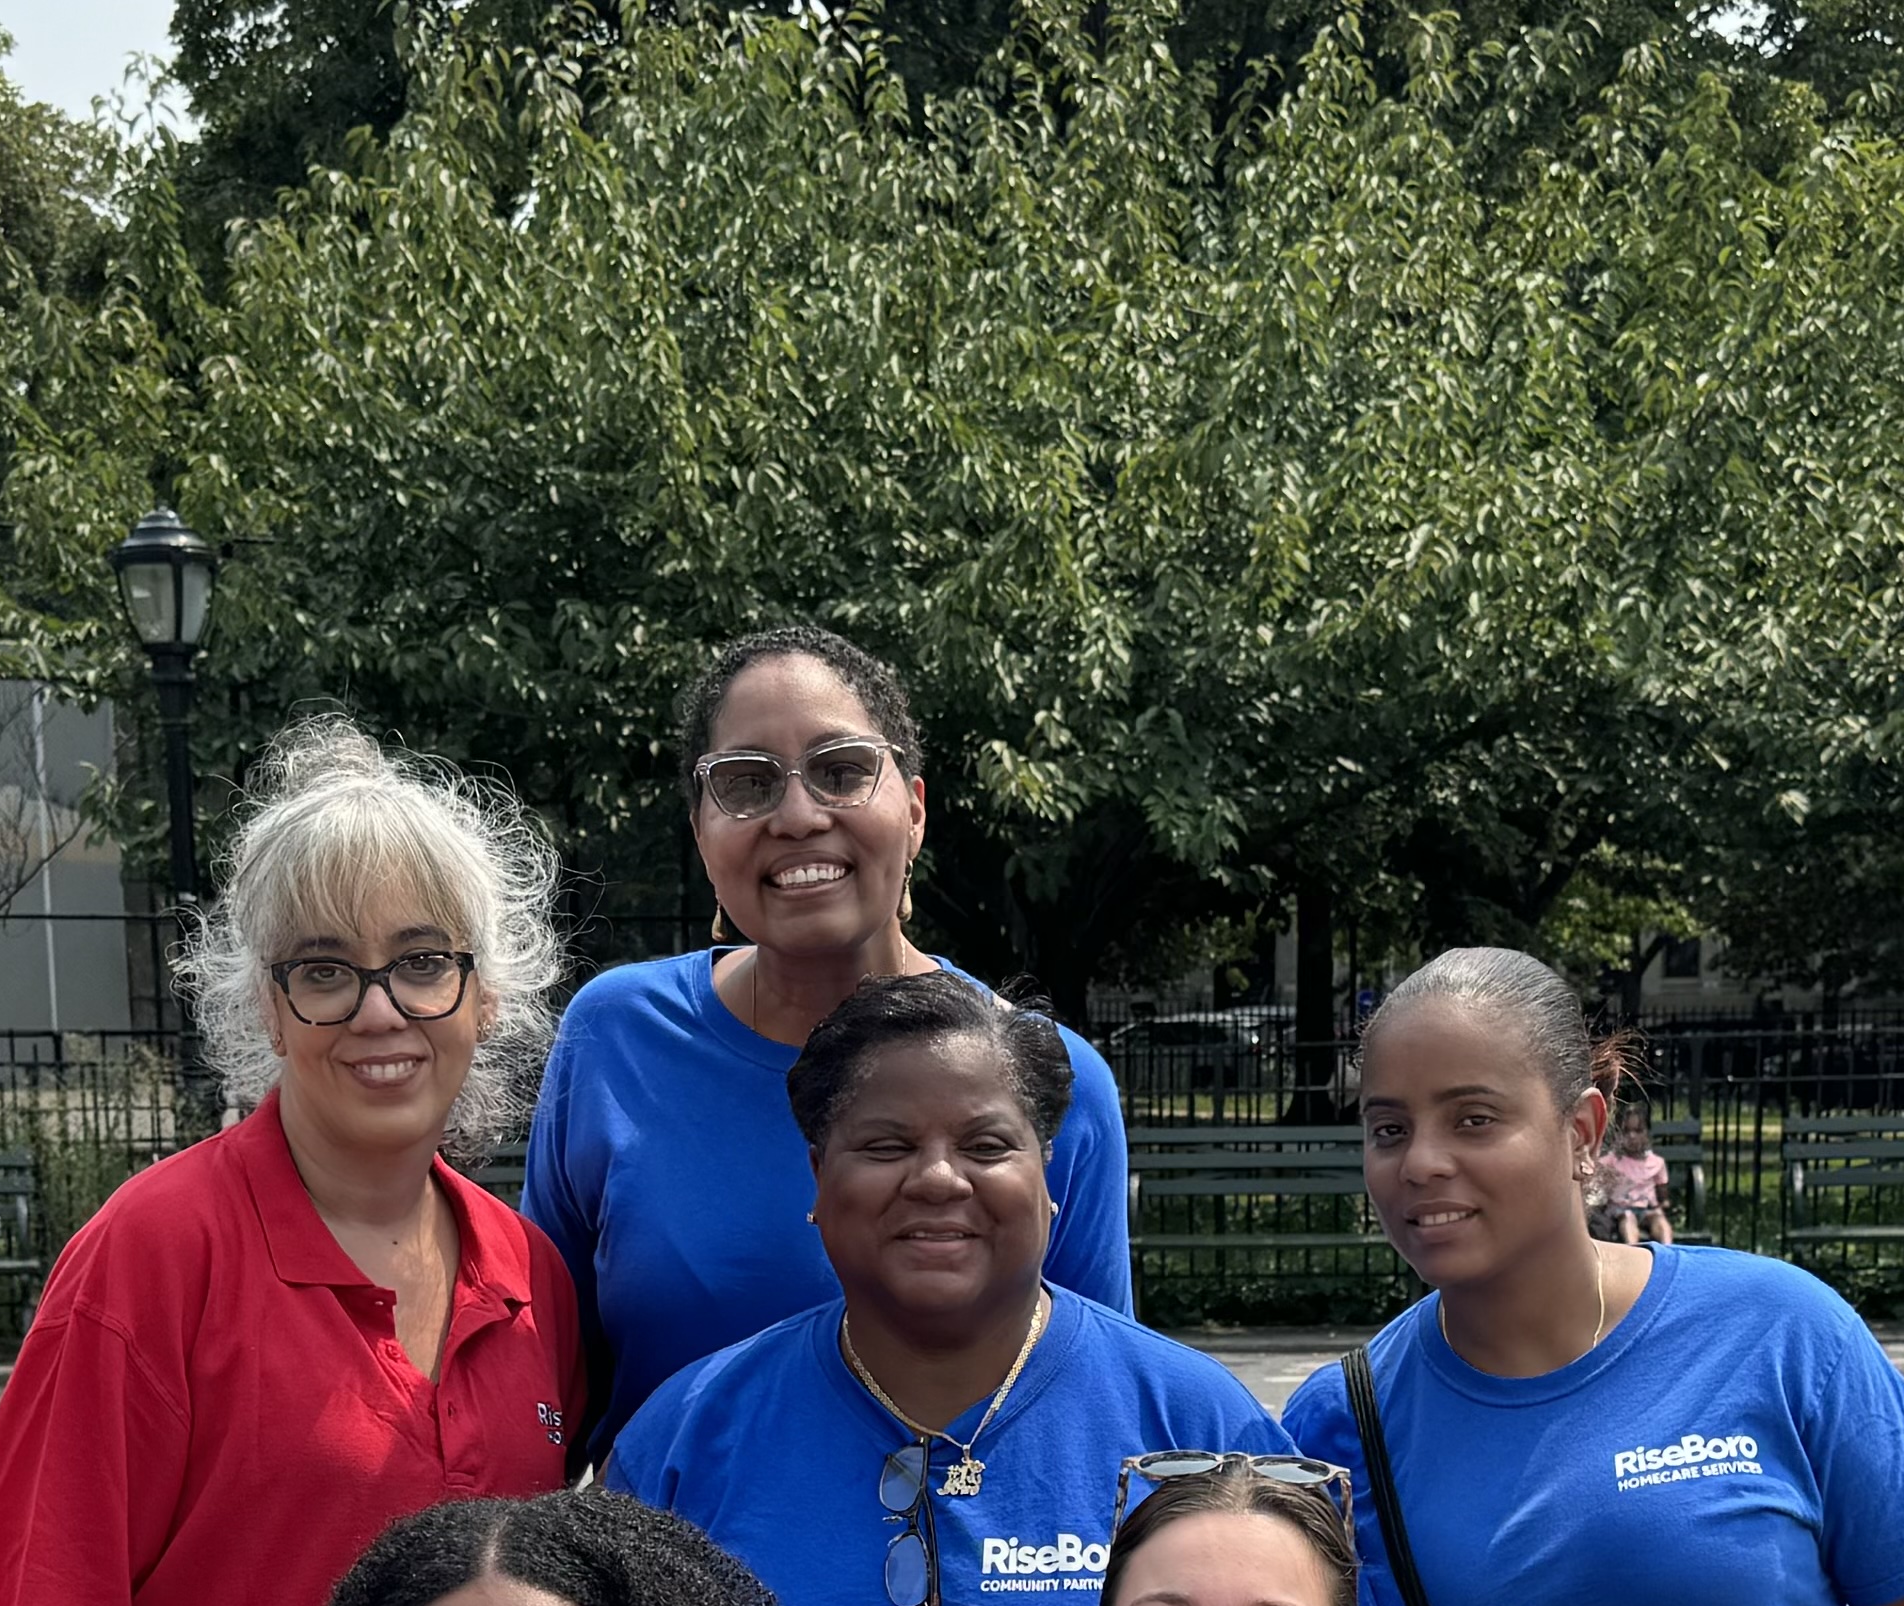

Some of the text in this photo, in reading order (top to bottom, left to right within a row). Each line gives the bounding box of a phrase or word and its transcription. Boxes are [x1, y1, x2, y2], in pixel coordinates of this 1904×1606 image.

[1614, 1434, 1758, 1478] RiseBoro
[1617, 1461, 1763, 1492] HOMECARE SERVICES
[980, 1578, 1059, 1592] COMMUNITY
